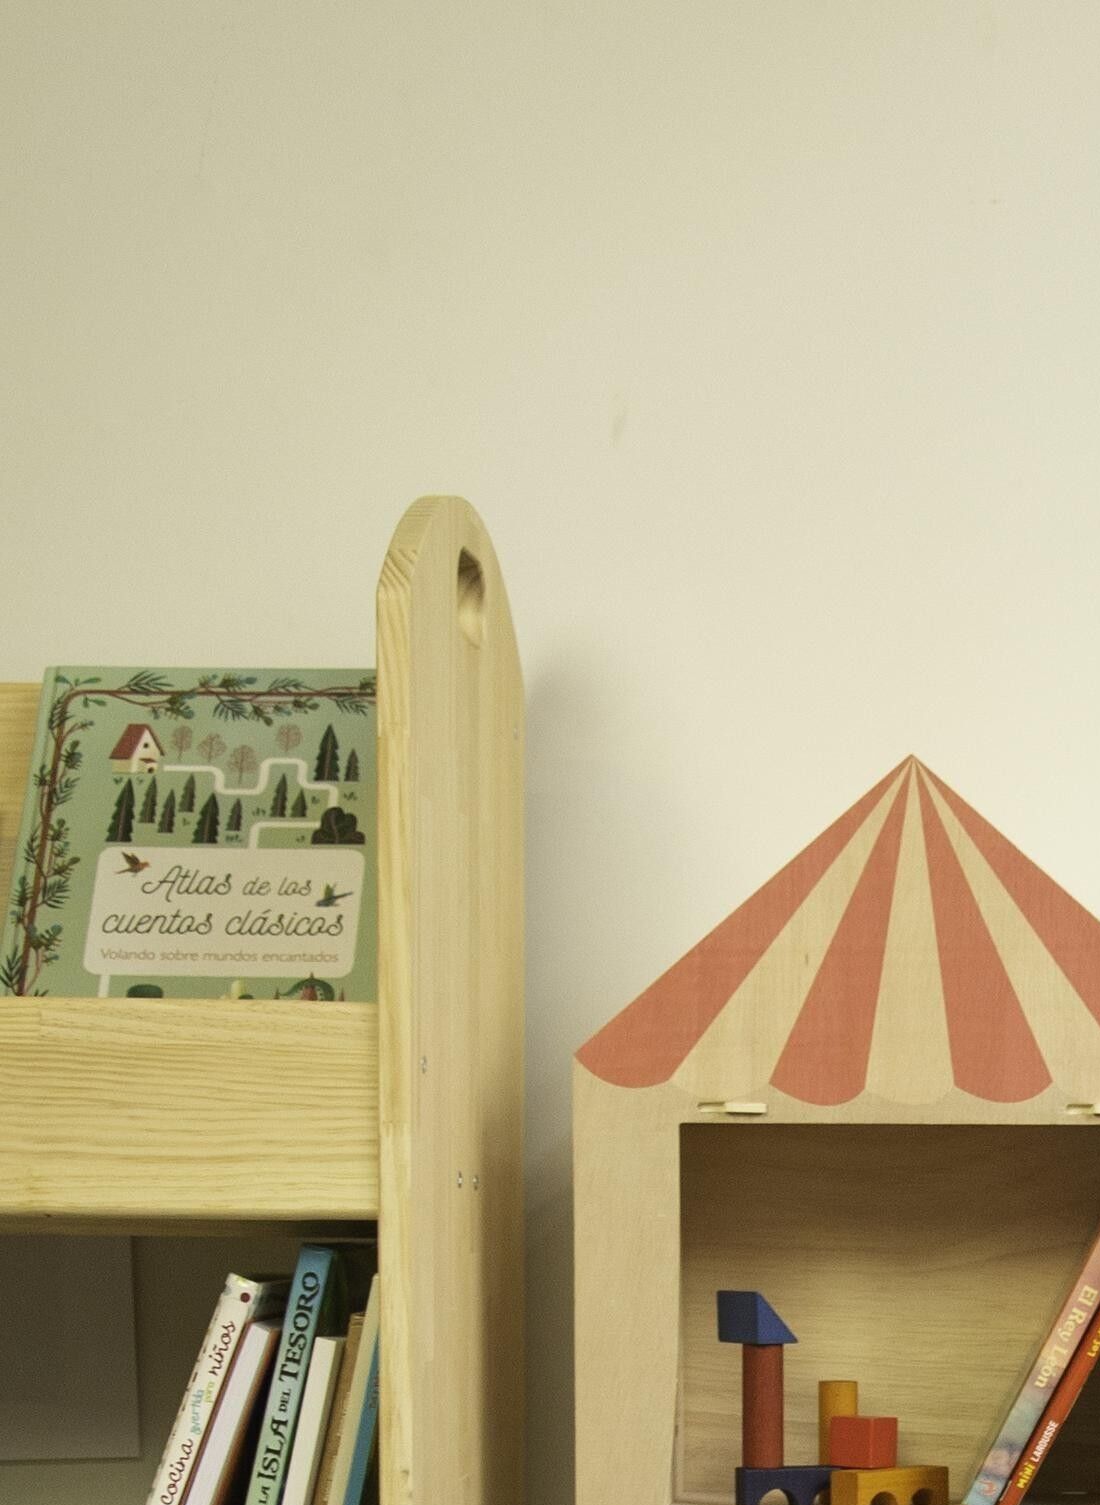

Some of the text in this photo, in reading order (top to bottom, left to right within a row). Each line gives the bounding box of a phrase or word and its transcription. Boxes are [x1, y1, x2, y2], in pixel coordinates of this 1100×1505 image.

[141, 865, 312, 902] Atlas de los
[102, 908, 344, 937] cuentos clásicos
[100, 949, 339, 963] Volando sobre mundos encantados
[1078, 1284, 1099, 1307] El
[1058, 1307, 1088, 1342] Rey
[209, 1321, 236, 1376] niños
[256, 1271, 321, 1504] LA ISLA DEL TESORO
[1030, 1420, 1059, 1463] LAROUSSE
